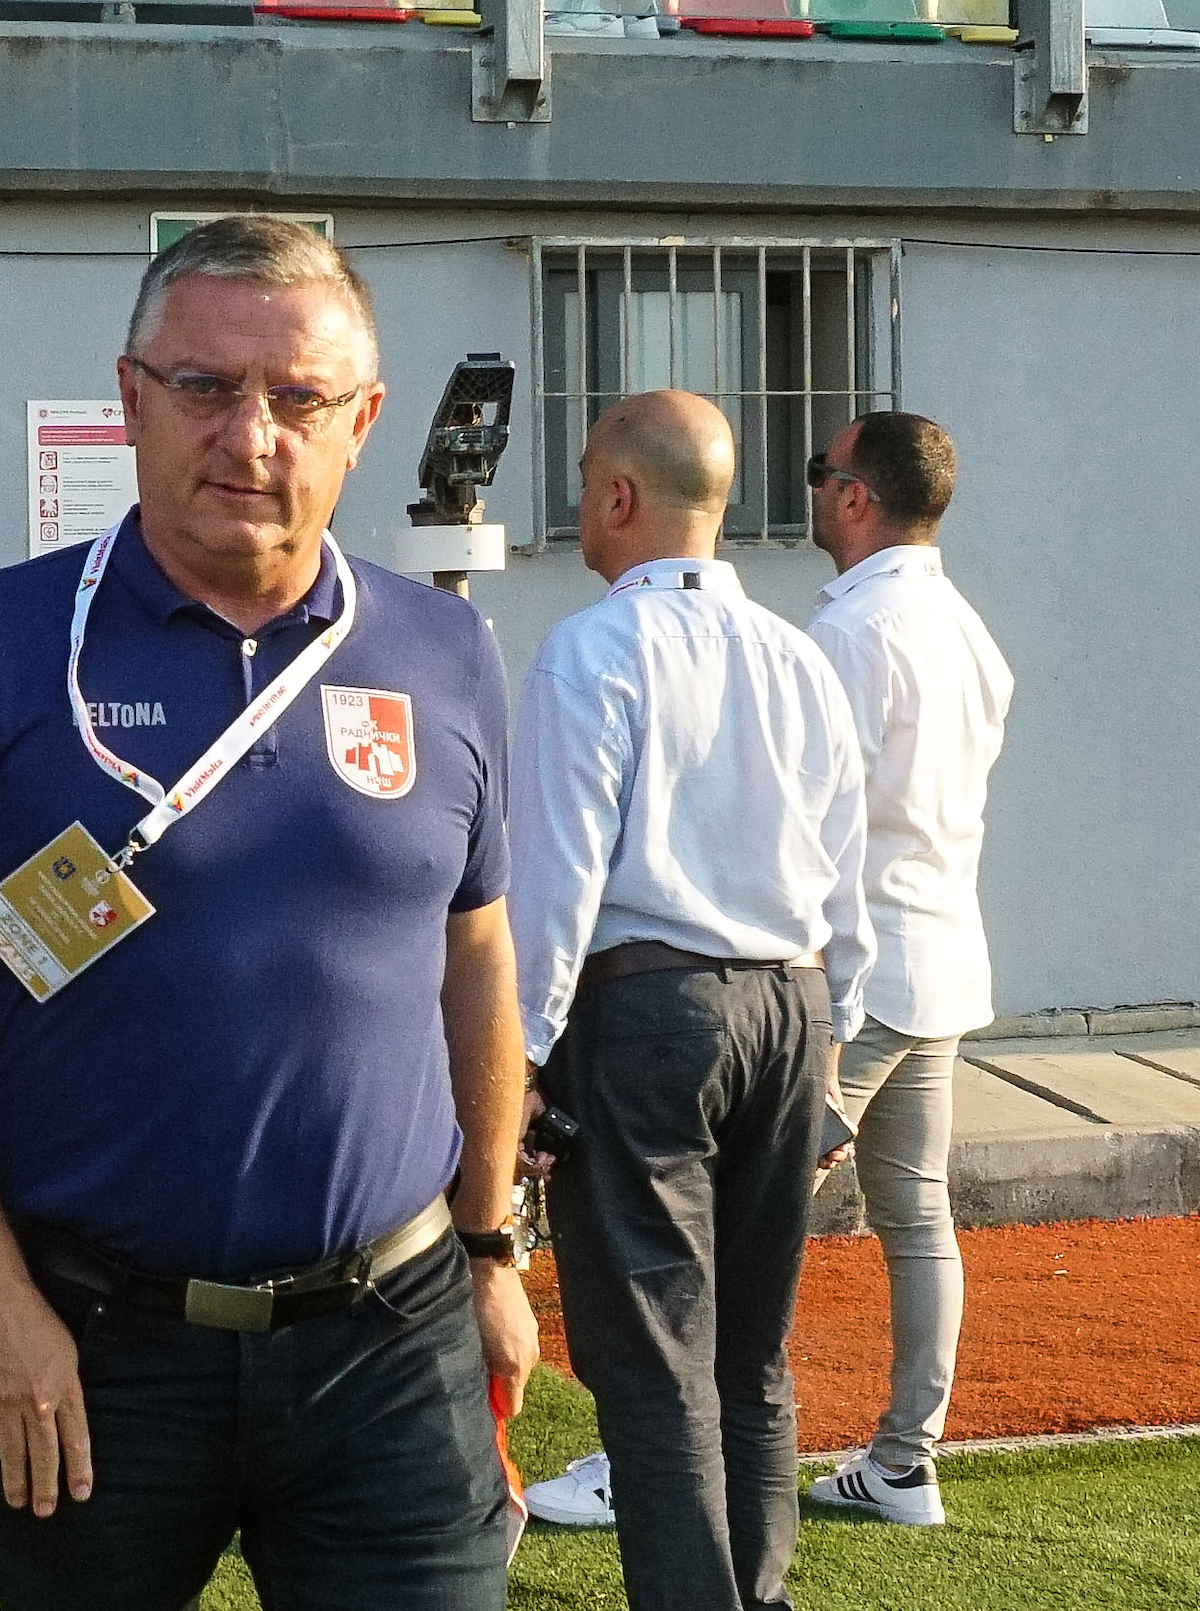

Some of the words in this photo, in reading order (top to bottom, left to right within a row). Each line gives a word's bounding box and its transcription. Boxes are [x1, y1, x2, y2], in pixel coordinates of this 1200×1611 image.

[332, 693, 364, 707] 1923
[72, 702, 167, 728] ELTONA
[183, 759, 224, 798] VisitMalta
